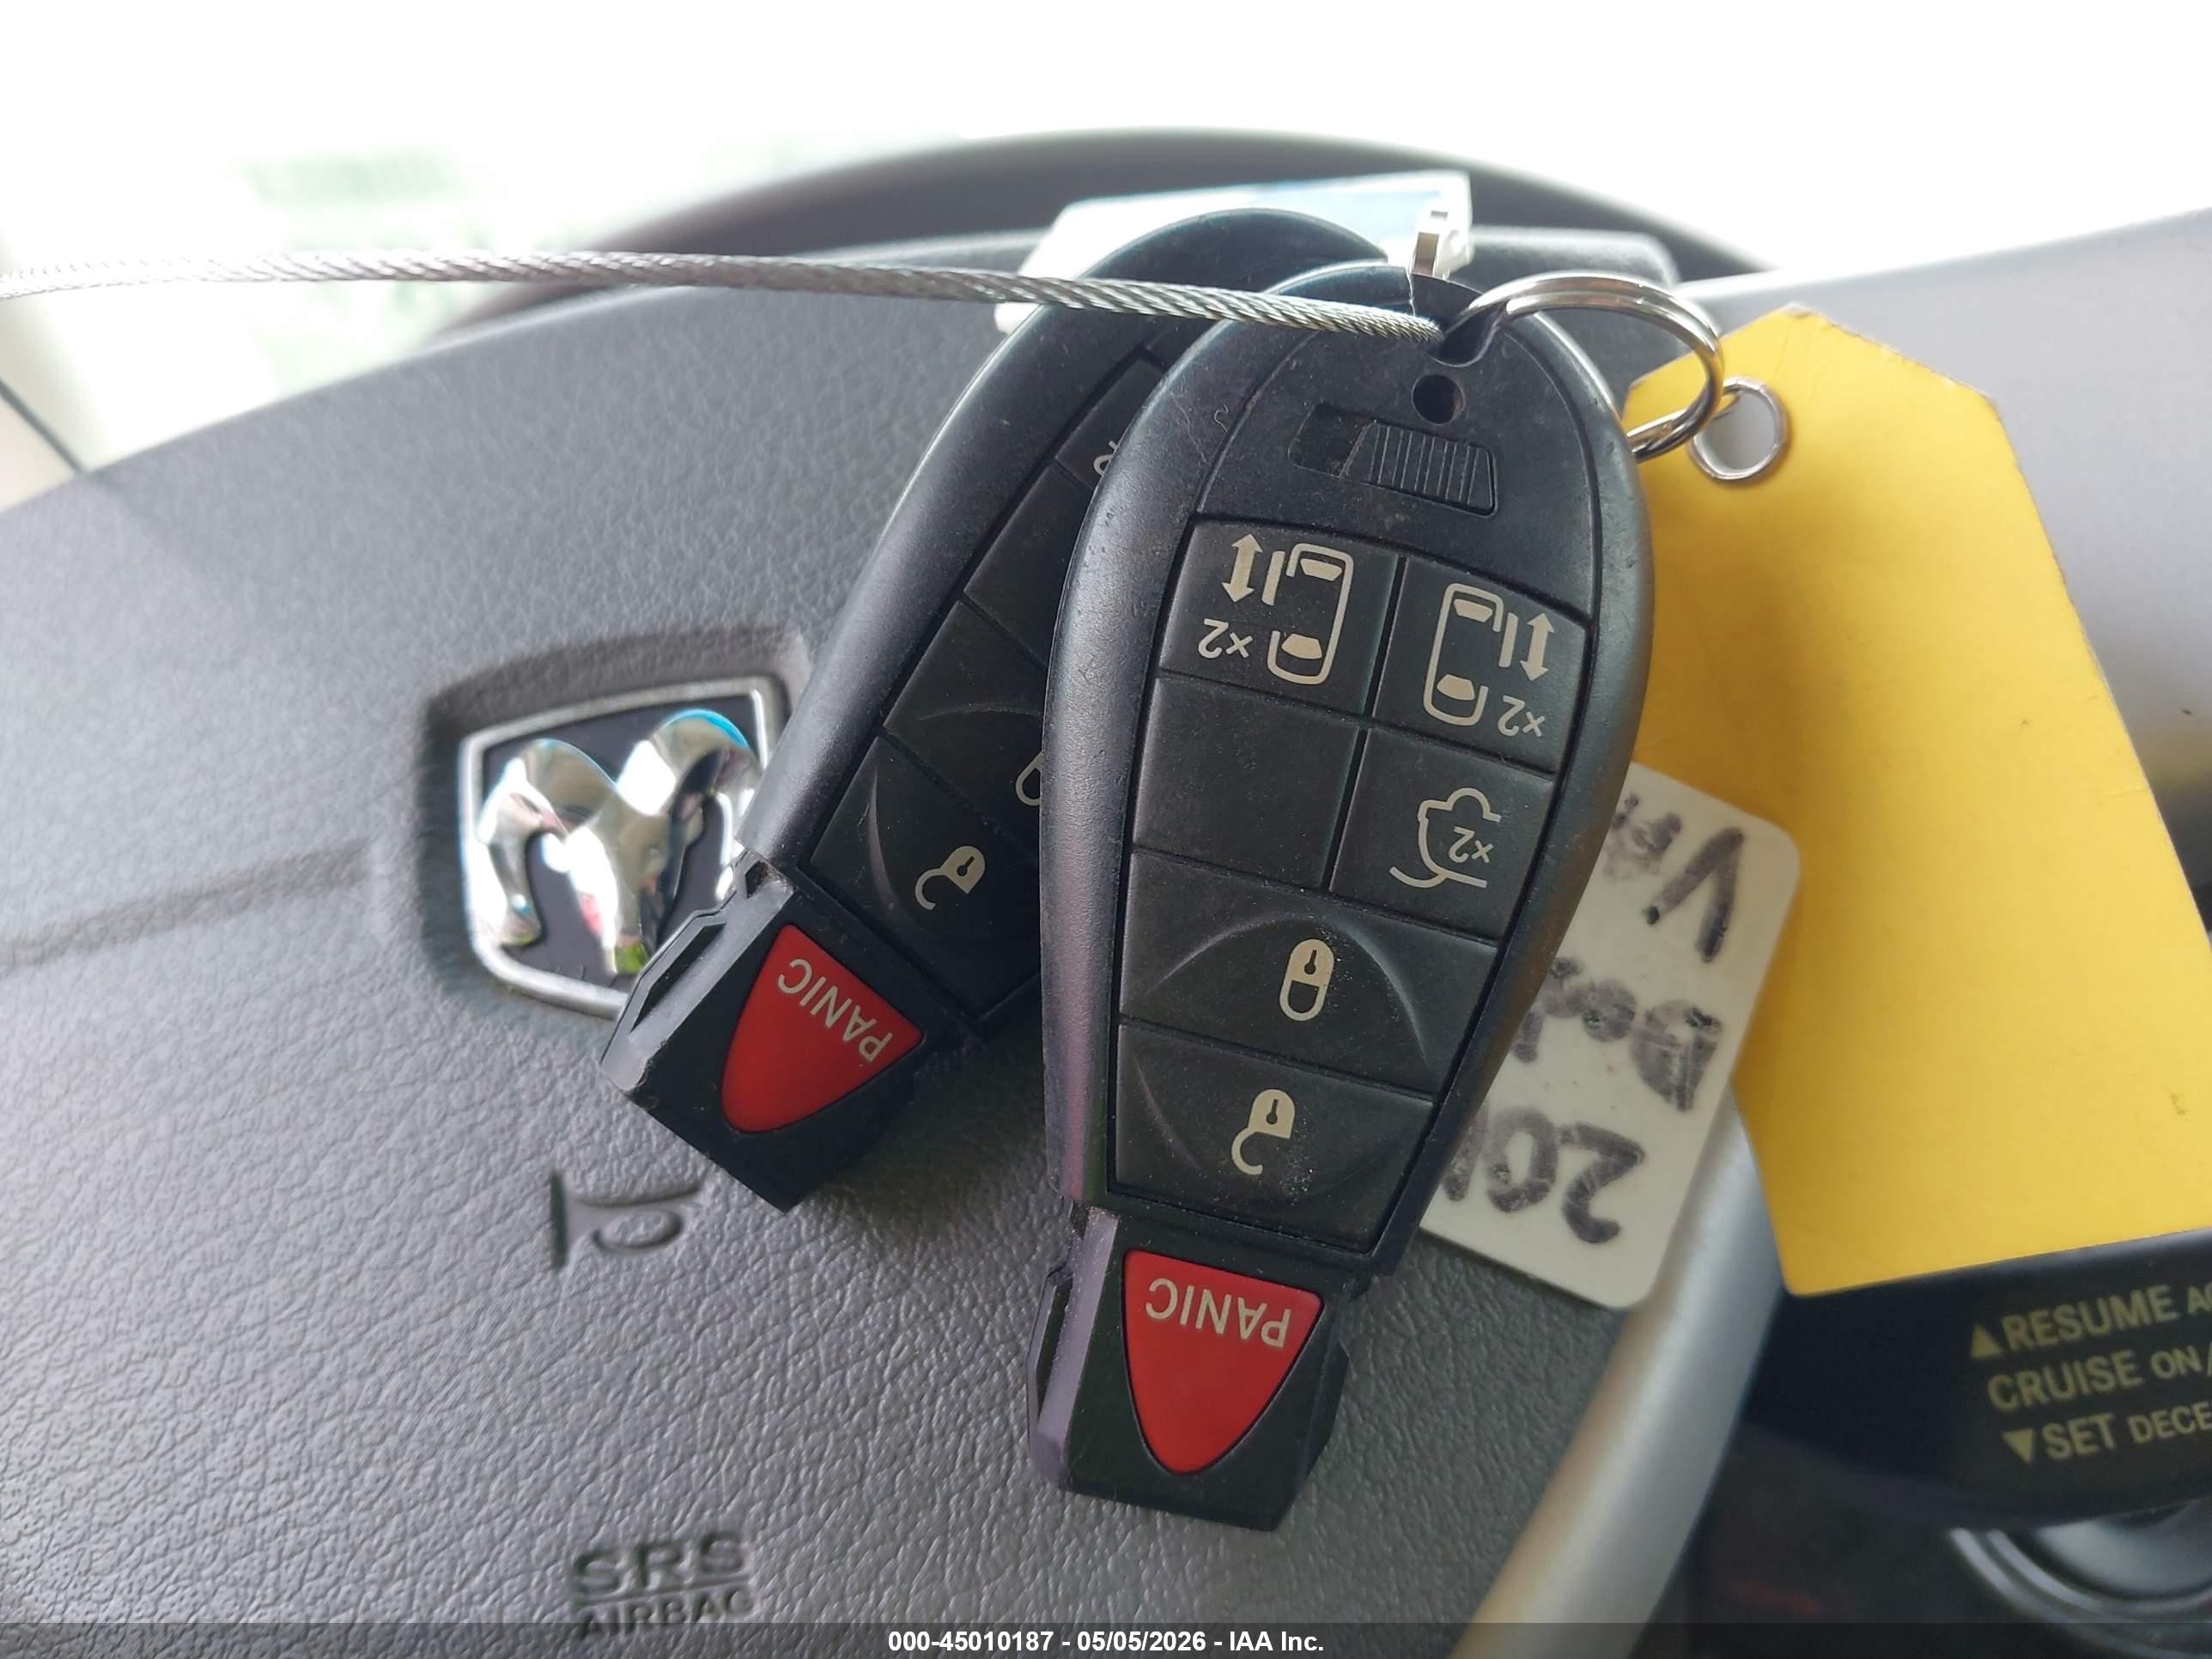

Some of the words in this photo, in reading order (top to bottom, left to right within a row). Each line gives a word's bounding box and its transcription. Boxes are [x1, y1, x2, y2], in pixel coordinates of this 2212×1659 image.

[778, 957, 894, 1062] PANIC
[1145, 1277, 1292, 1348] PANIC
[2001, 1285, 2182, 1351] RESUME
[1987, 1349, 2146, 1414] CRUISE
[2041, 1413, 2118, 1460] SET
[574, 1530, 747, 1601] SRS
[575, 1583, 756, 1642] AIRBAG
